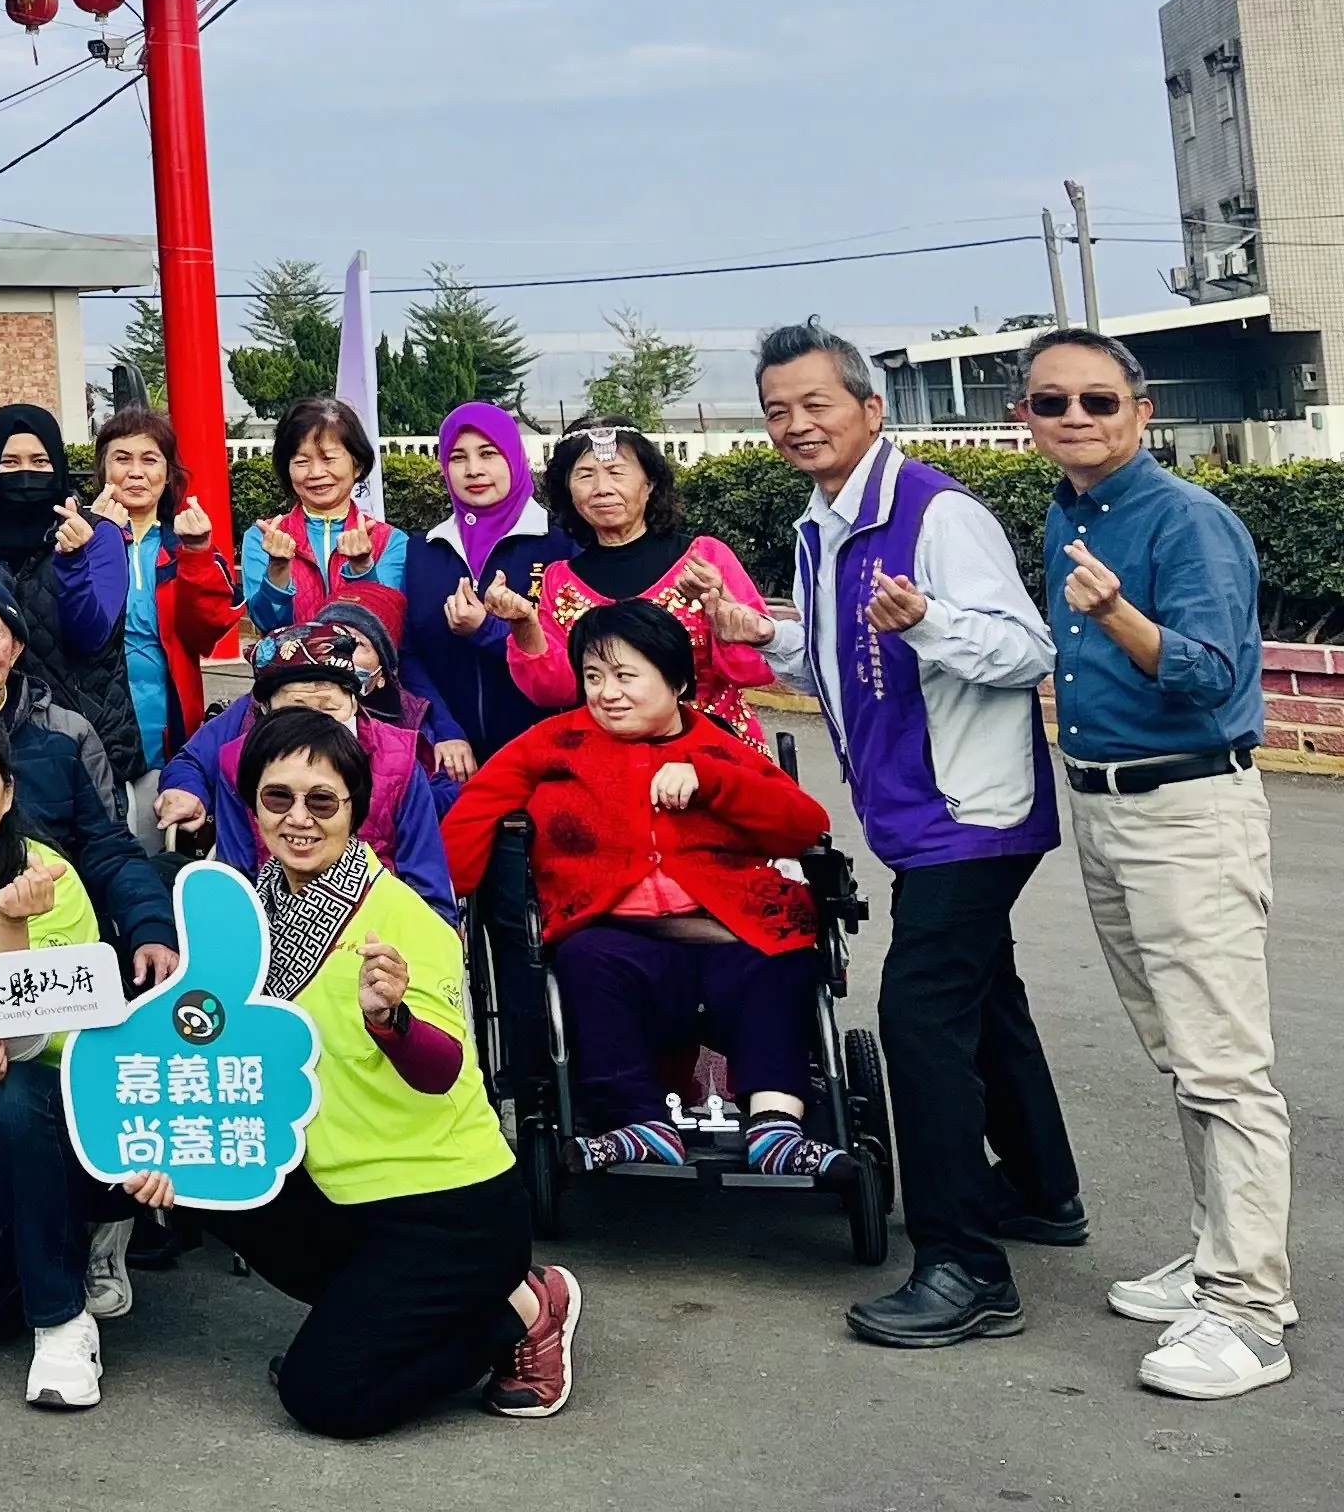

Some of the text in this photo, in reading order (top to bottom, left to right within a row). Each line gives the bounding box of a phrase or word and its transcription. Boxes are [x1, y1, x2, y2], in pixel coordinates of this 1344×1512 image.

[34, 1001, 99, 1016] Government
[115, 1053, 264, 1105] 嘉義縣
[117, 1115, 266, 1167] 尚蓋讚
